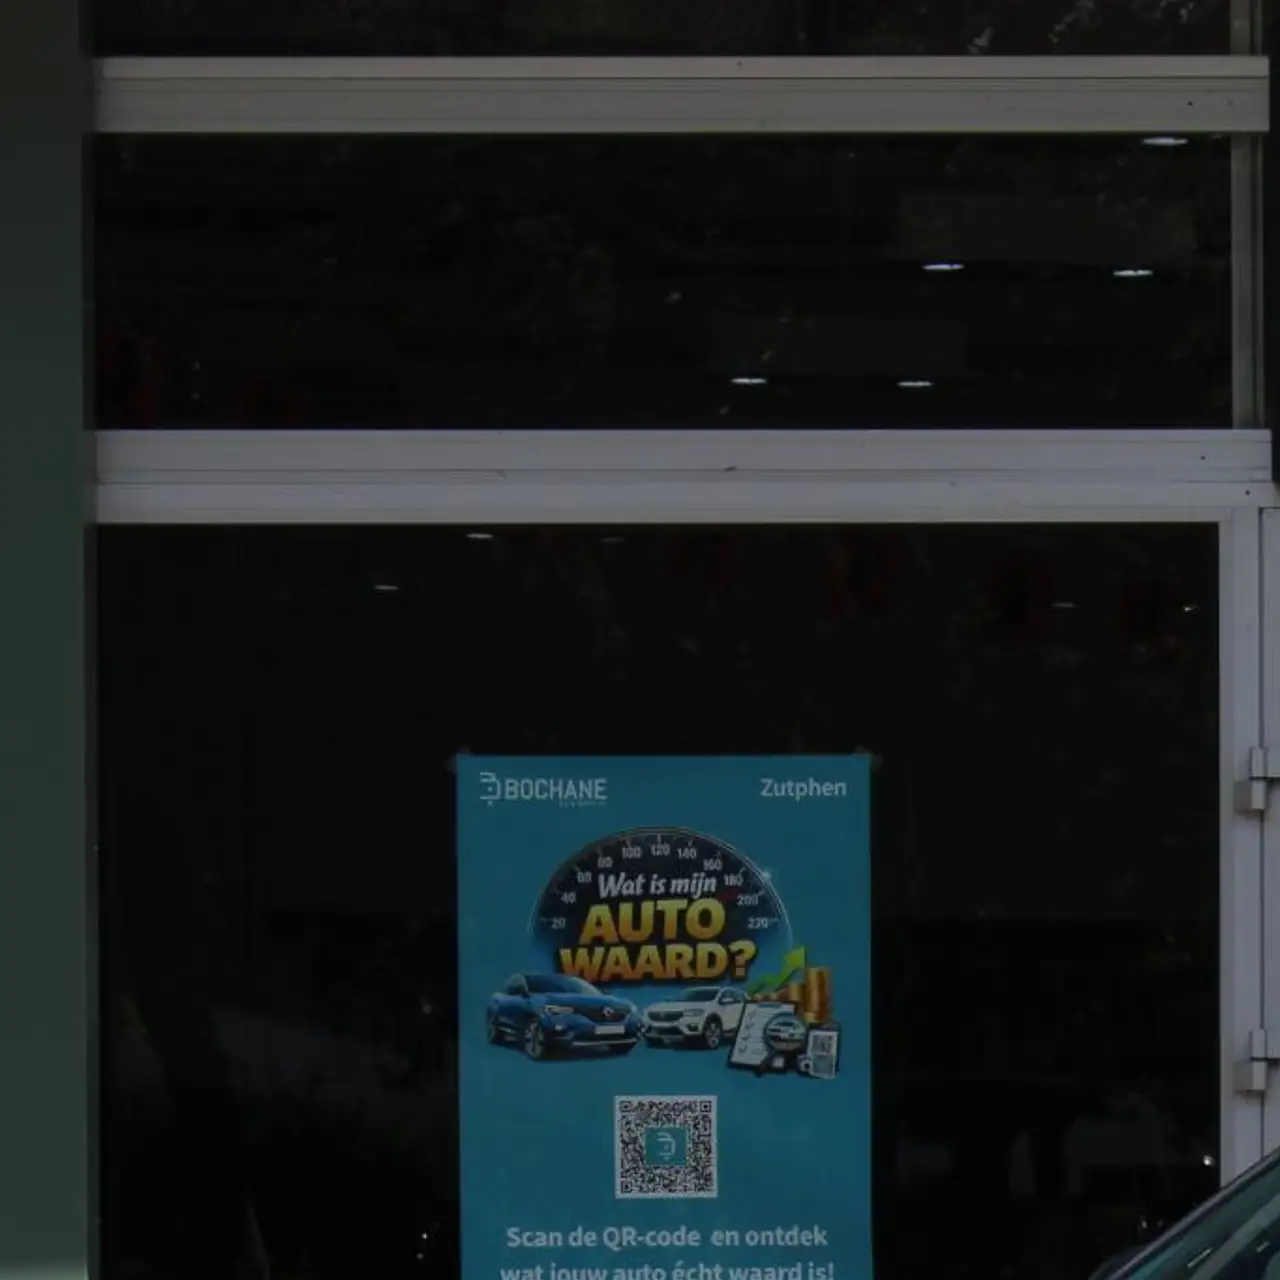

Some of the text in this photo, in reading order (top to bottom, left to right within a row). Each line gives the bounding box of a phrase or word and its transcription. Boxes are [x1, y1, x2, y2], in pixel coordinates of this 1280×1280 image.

[505, 778, 608, 801] BOCHANE
[760, 777, 847, 802] Zutphen
[597, 871, 718, 900] Wat is mijn
[579, 898, 726, 945] AUTO
[559, 940, 757, 982] WAARD?
[506, 1225, 828, 1251] Scan de QR-code en ontdek
